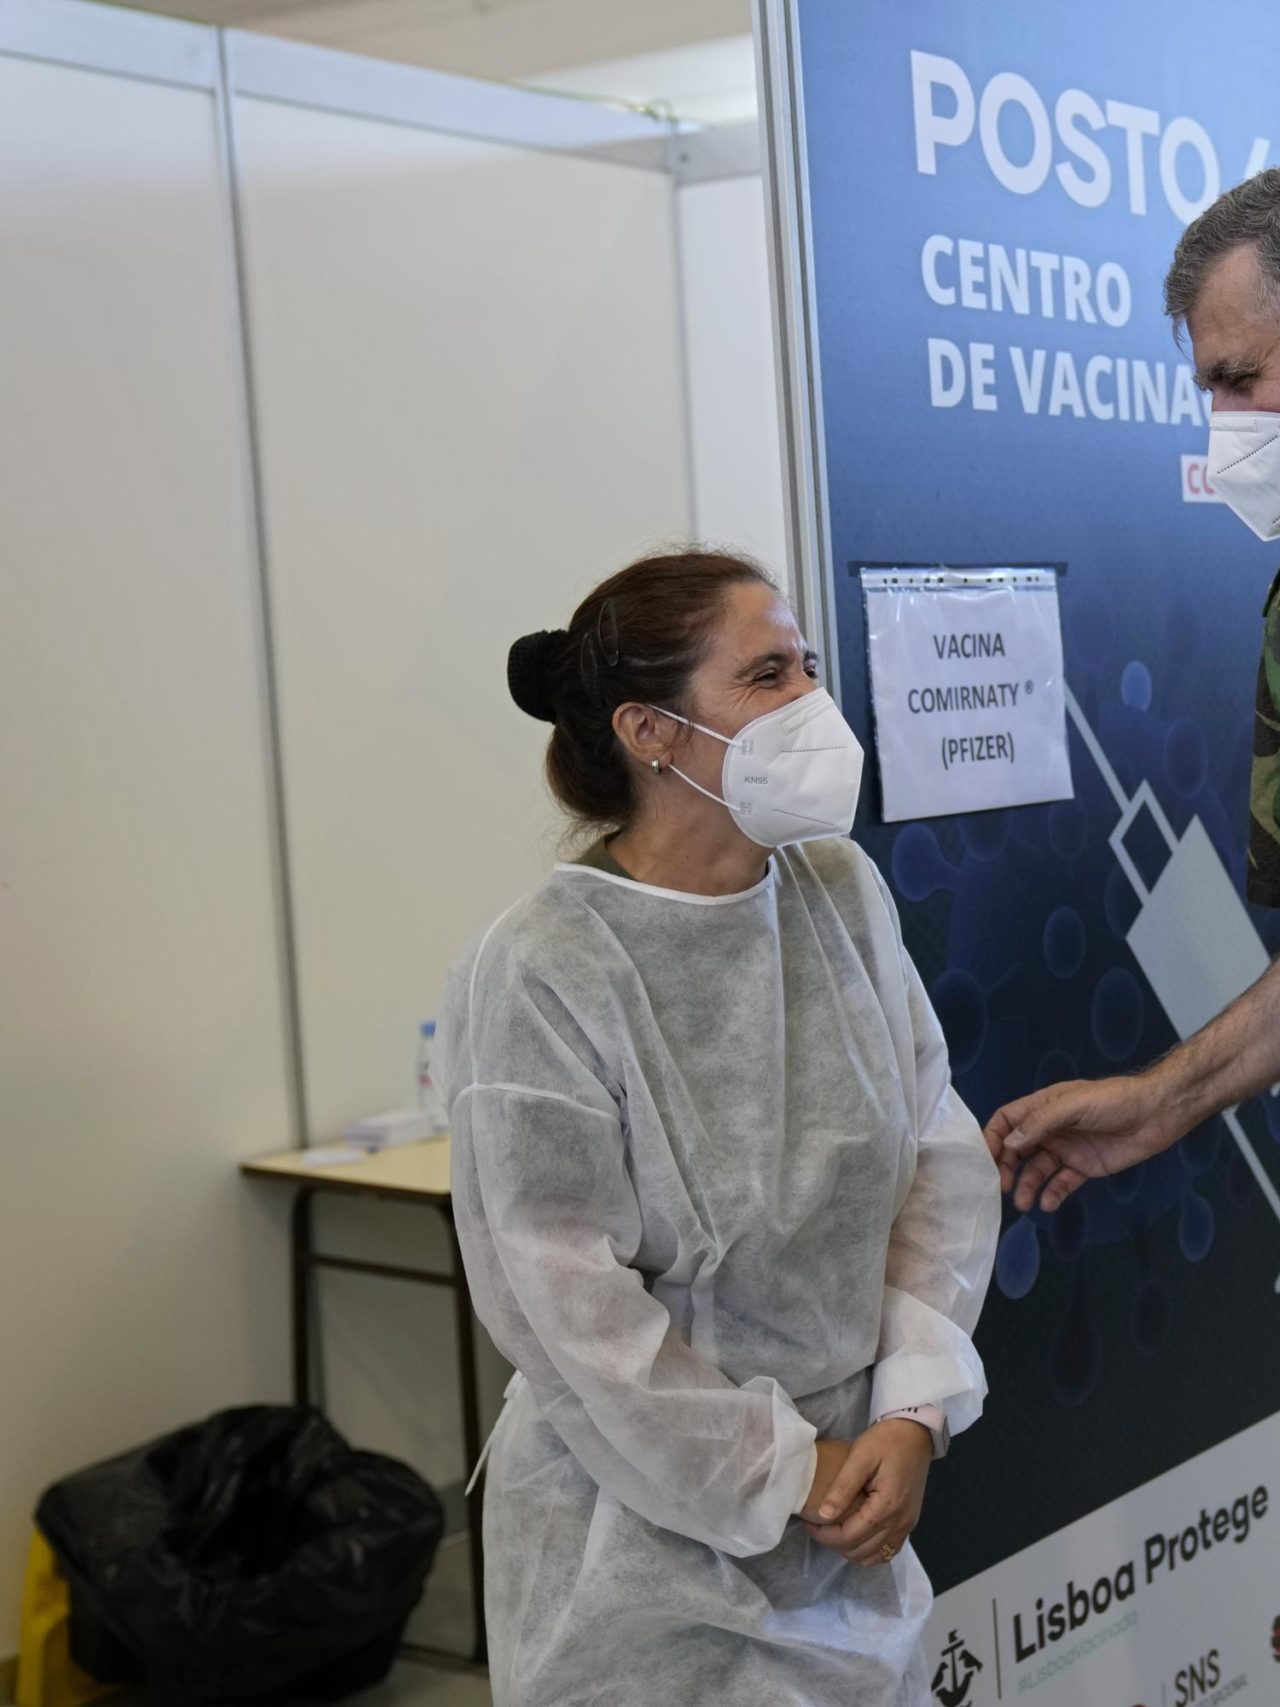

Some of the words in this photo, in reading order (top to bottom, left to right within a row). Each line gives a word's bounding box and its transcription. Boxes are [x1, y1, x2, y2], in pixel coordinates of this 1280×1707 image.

[910, 49, 1221, 227] POSTO
[921, 234, 1132, 328] CENTRO
[927, 337, 998, 411] DE
[933, 633, 1006, 659] VACINA
[908, 683, 1020, 714] COMIRNATY
[744, 775, 768, 785] KN95
[941, 732, 1015, 770] (PFIZER)
[1012, 1559, 1136, 1664] Lisboa
[1144, 1485, 1269, 1584] Protege
[1174, 1648, 1221, 1707] SNS
